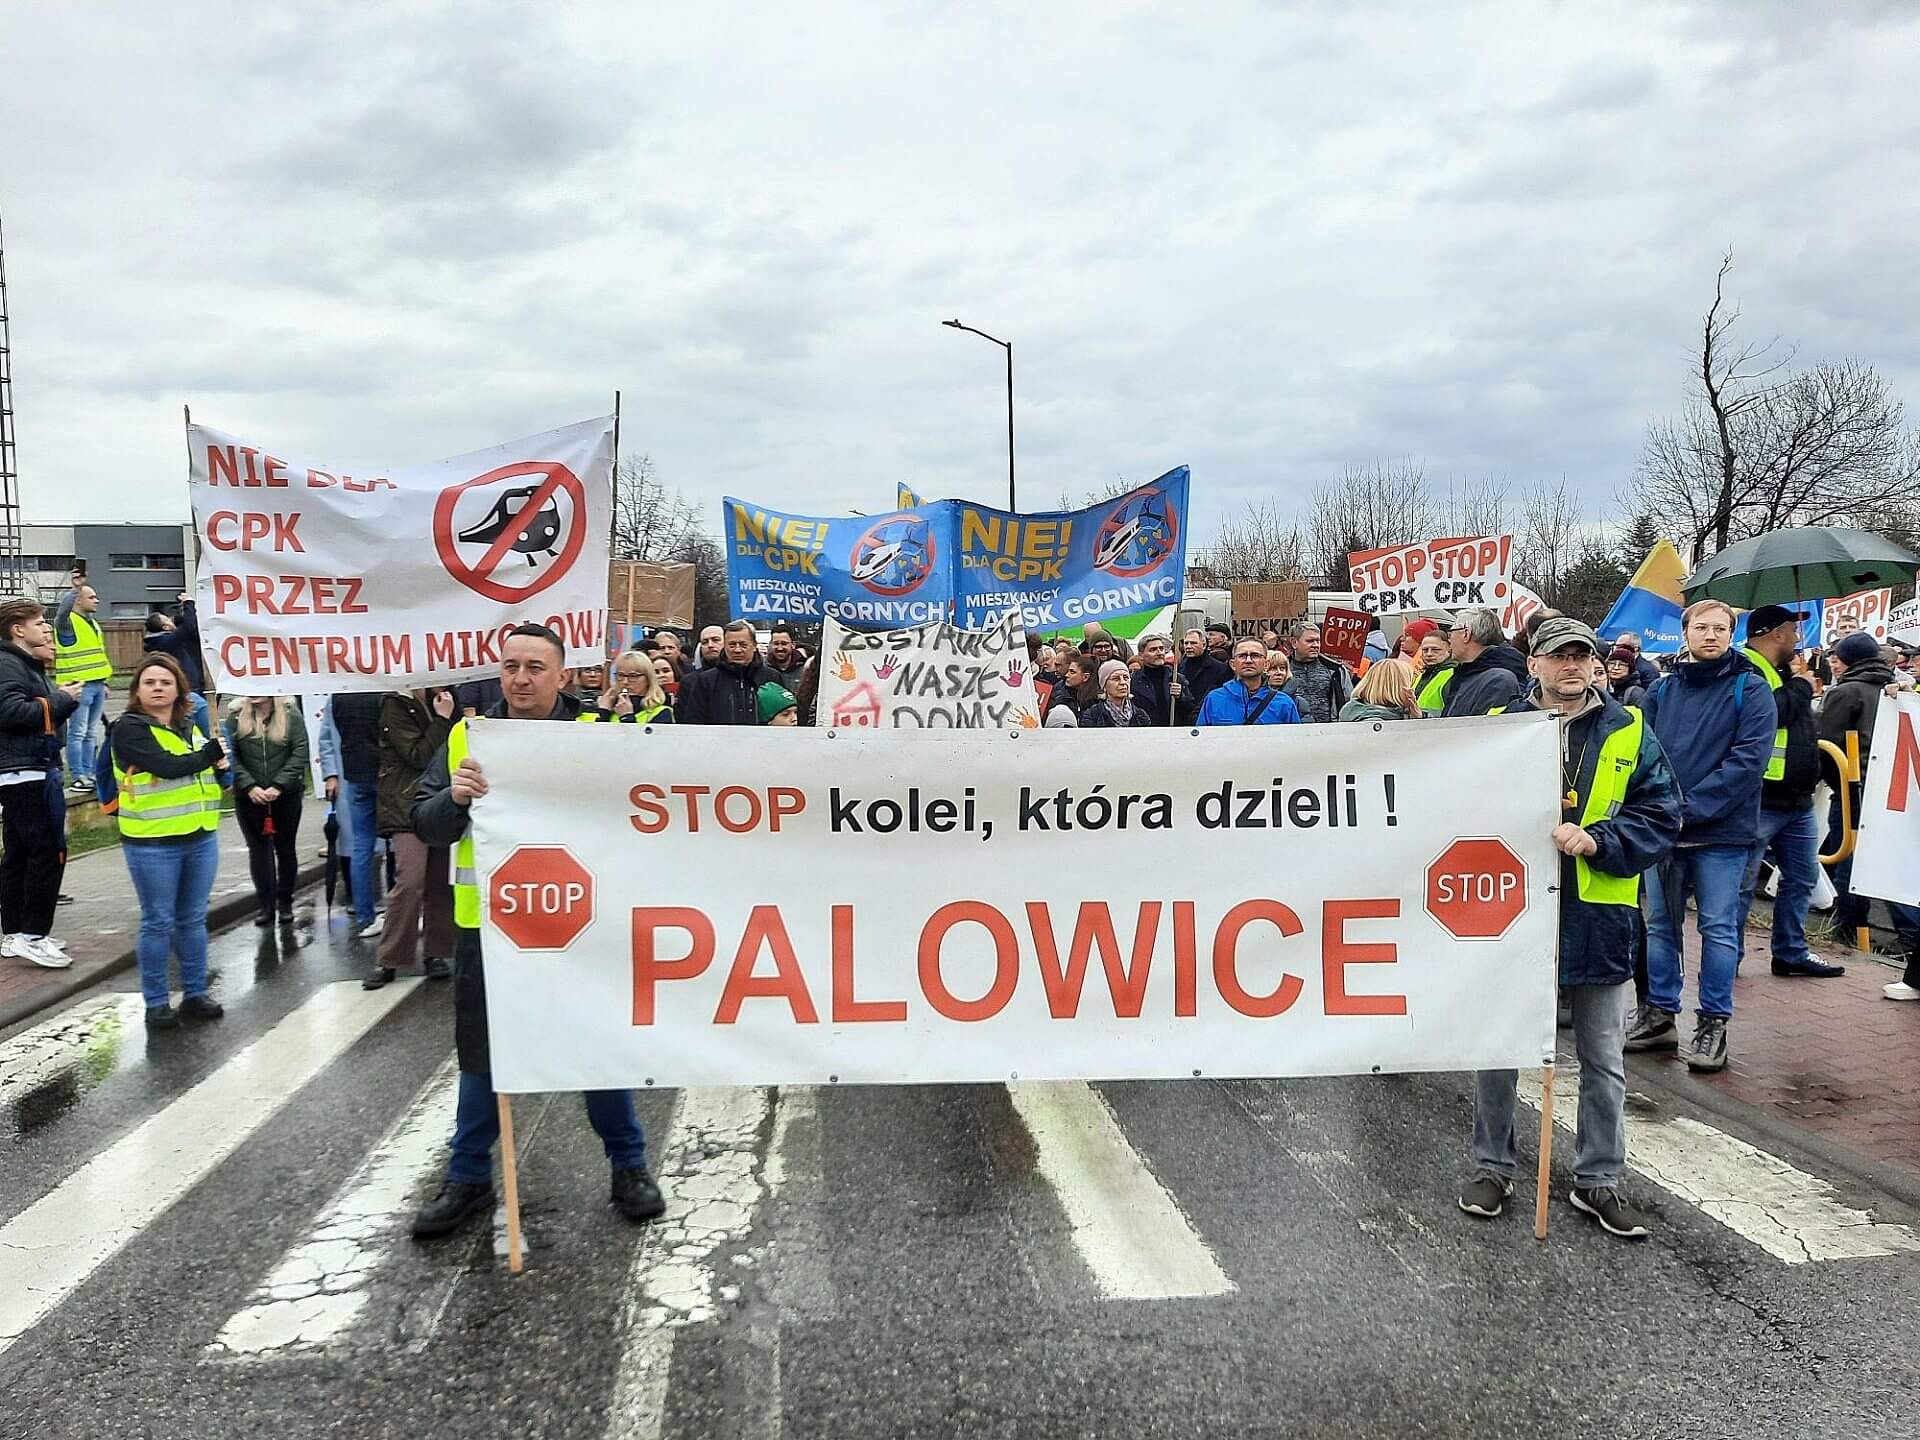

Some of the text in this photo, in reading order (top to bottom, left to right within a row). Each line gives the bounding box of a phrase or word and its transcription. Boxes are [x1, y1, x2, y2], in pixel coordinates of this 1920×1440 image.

[208, 445, 289, 487] NIE
[207, 511, 306, 553] CPK
[734, 504, 829, 550] NIE!
[961, 509, 1072, 558] NIE!
[737, 544, 820, 576] DLA CPK
[962, 555, 1067, 582] DLA CPK
[1351, 549, 1427, 593] STOP
[1432, 535, 1512, 598] STOP!
[212, 574, 368, 615] PRZEZ
[739, 578, 822, 597] MIESZKAŃCY
[966, 586, 1061, 609] MIESZKAŃCY
[1359, 587, 1420, 614] CPK
[1434, 581, 1486, 604] CPK
[740, 594, 945, 622] ŁAZISK GÓRNYCH
[966, 604, 1060, 632] ŁASK
[1325, 628, 1362, 650] CPK
[1328, 616, 1367, 635] STOP!
[220, 609, 602, 678] CENTRUM MIKOOW
[893, 661, 1000, 700] NASZE
[892, 701, 1012, 728] DOMY
[629, 783, 808, 834] STOP
[829, 785, 994, 842] kolei,
[1018, 784, 1174, 832] która
[1195, 774, 1358, 829] dzieli
[499, 882, 585, 914] STOP
[1436, 872, 1518, 903] STOP
[631, 898, 1407, 1026] PALOWICE
